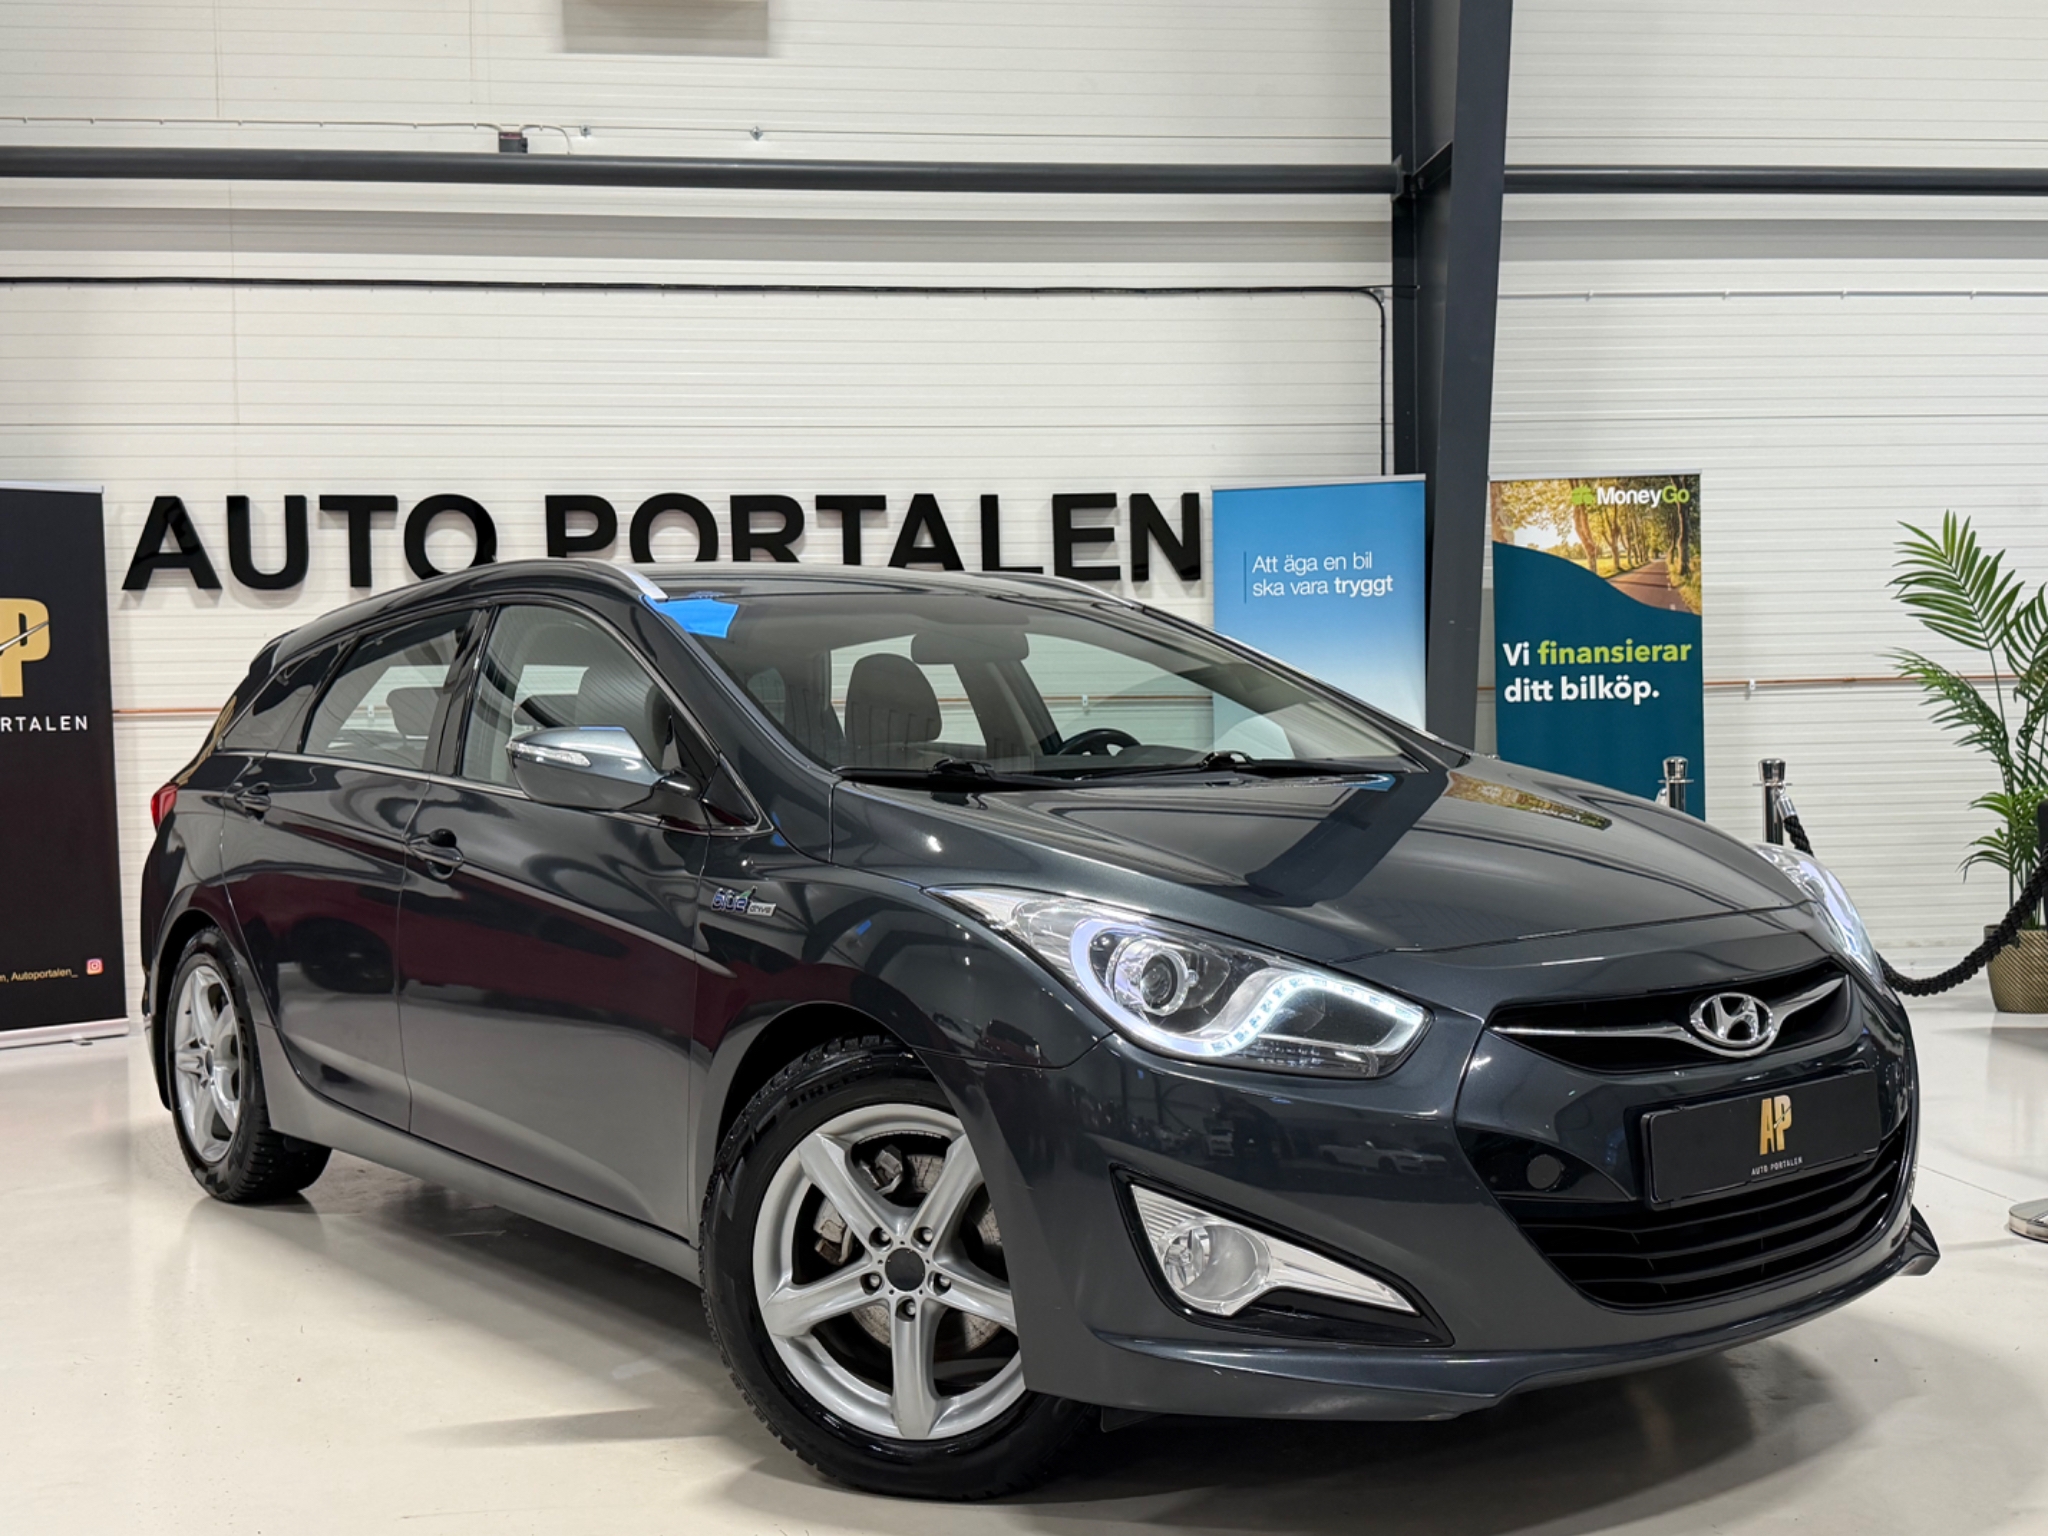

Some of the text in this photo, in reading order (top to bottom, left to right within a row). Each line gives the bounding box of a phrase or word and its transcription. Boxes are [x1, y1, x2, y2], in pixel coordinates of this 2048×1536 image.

[1597, 485, 1690, 508] MoneyGo
[121, 491, 1201, 591] AUTO PORTALEN
[1252, 551, 1372, 576] Att äga en bil
[1253, 575, 1393, 598] ska vara tryggt
[1502, 638, 1692, 666] Vi finansierar
[1504, 674, 1660, 706] ditt bilköp.
[1760, 1094, 1792, 1156] AP
